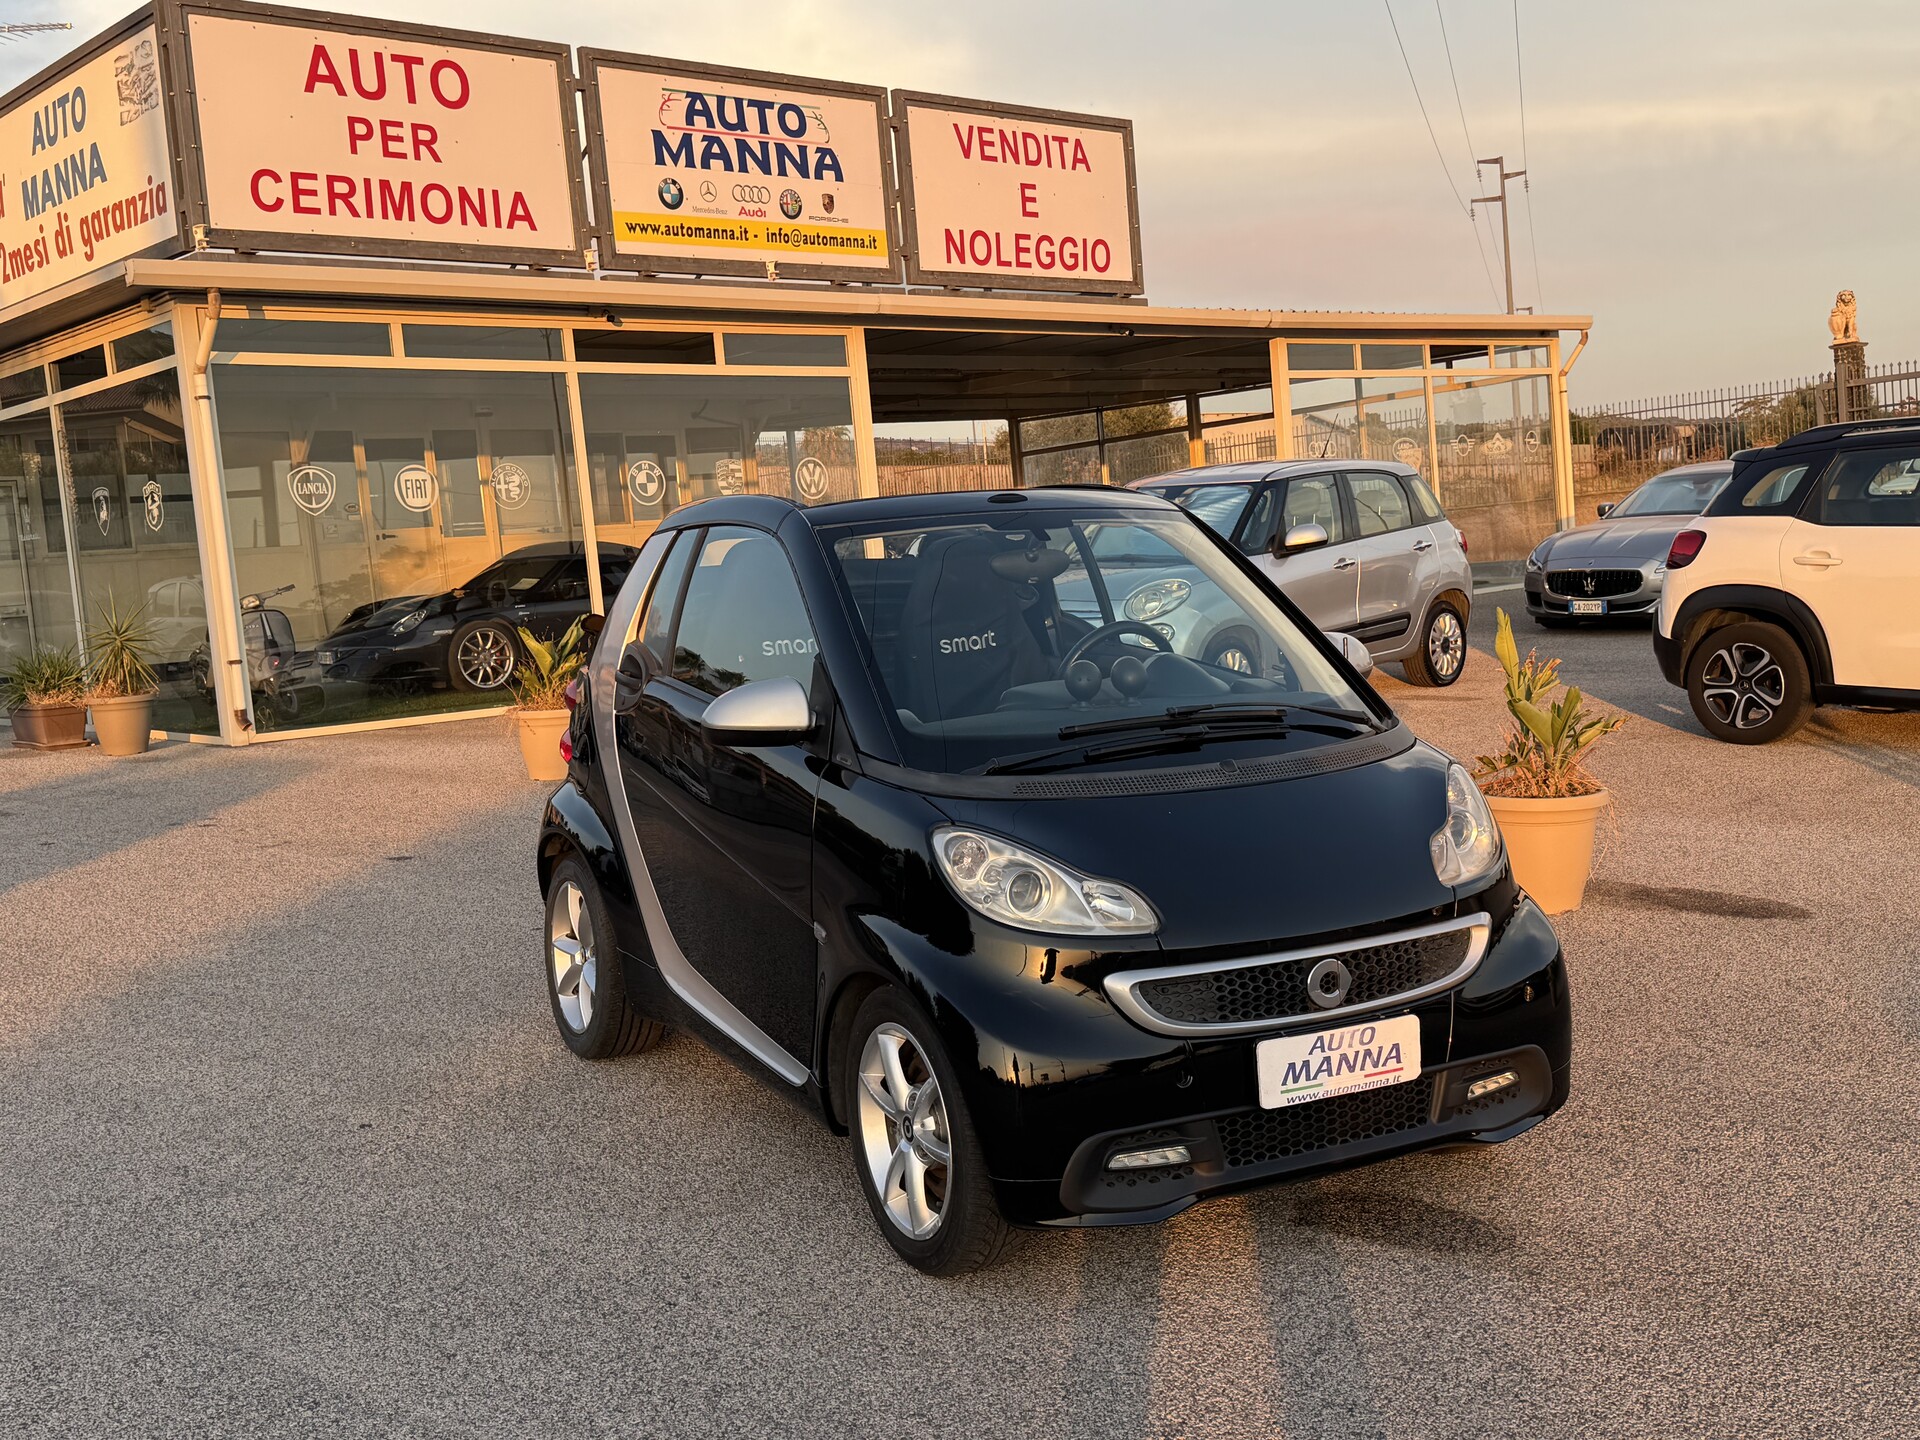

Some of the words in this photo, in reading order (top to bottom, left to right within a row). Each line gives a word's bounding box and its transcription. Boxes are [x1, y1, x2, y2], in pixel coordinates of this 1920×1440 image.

[304, 44, 470, 109] AUTO
[32, 85, 87, 156] AUTO
[684, 91, 807, 137] AUTO
[347, 116, 442, 163] PER
[651, 129, 844, 182] MANNA
[952, 123, 1092, 172] VENDITA
[21, 142, 108, 221] MANNA
[250, 169, 537, 232] CERIMONIA
[1020, 183, 1039, 218] E
[54, 212, 74, 259] di
[79, 175, 168, 262] garanzia
[738, 206, 767, 218] Audi
[808, 216, 849, 224] PORSCHE
[625, 221, 749, 242] www.automanna.it
[766, 228, 878, 250] info@automanna.it
[944, 229, 1111, 272] NOLEGGIO
[297, 482, 328, 495] LANCIA
[404, 478, 427, 499] FIAT
[631, 463, 661, 477] BMW
[762, 638, 818, 656] smar
[939, 630, 996, 654] smart
[1308, 1026, 1376, 1056] AUTO
[1280, 1042, 1403, 1087] MANNA
[1285, 1074, 1402, 1105] www.automanna.it
